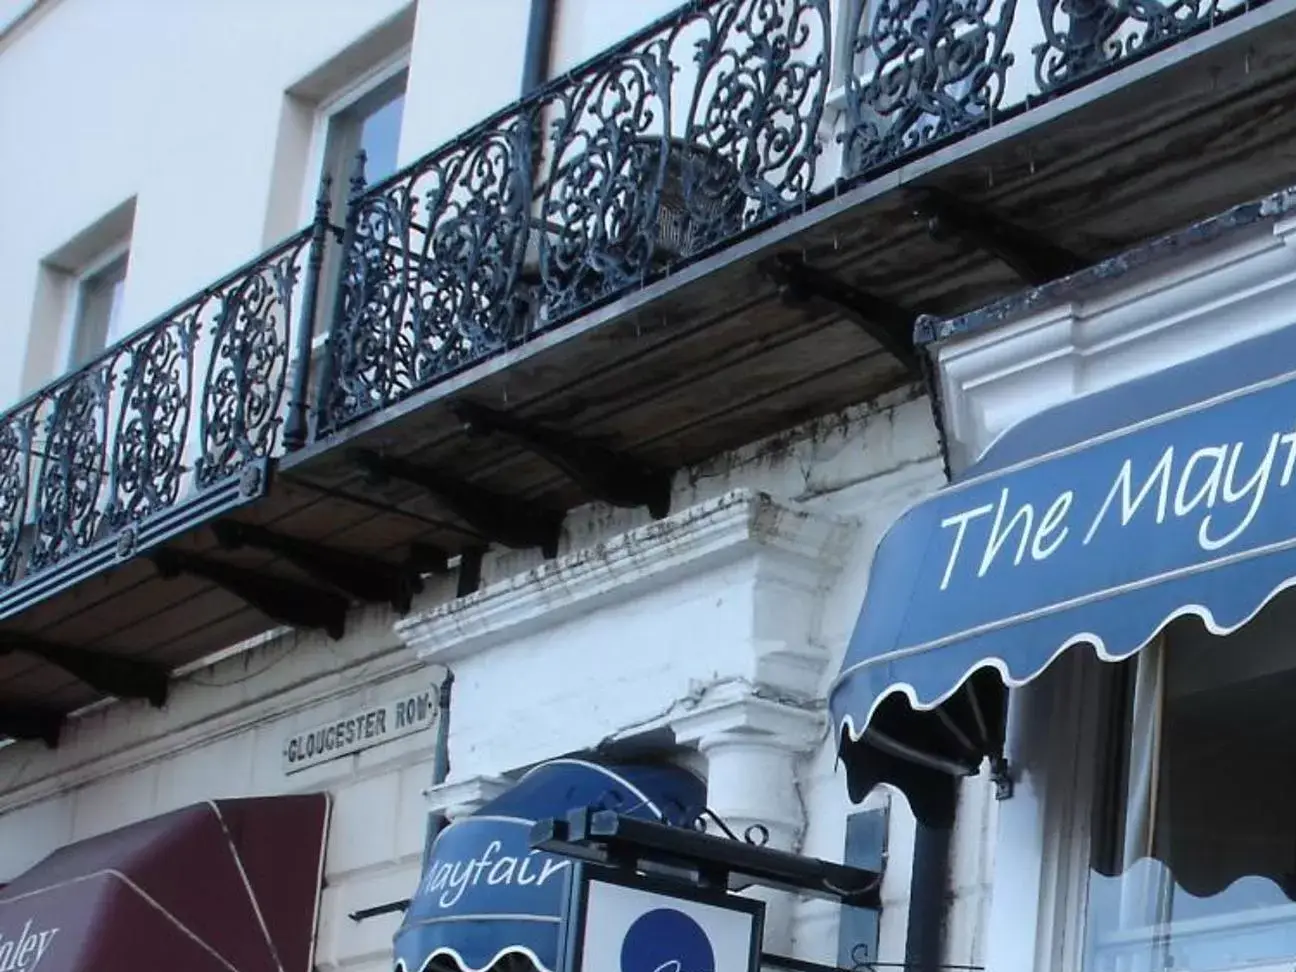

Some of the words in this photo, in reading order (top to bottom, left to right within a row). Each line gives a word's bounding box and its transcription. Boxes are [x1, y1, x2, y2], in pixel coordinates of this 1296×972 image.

[940, 487, 1073, 590] The
[288, 709, 387, 763] GLOUCESTER
[395, 692, 429, 730] ROW
